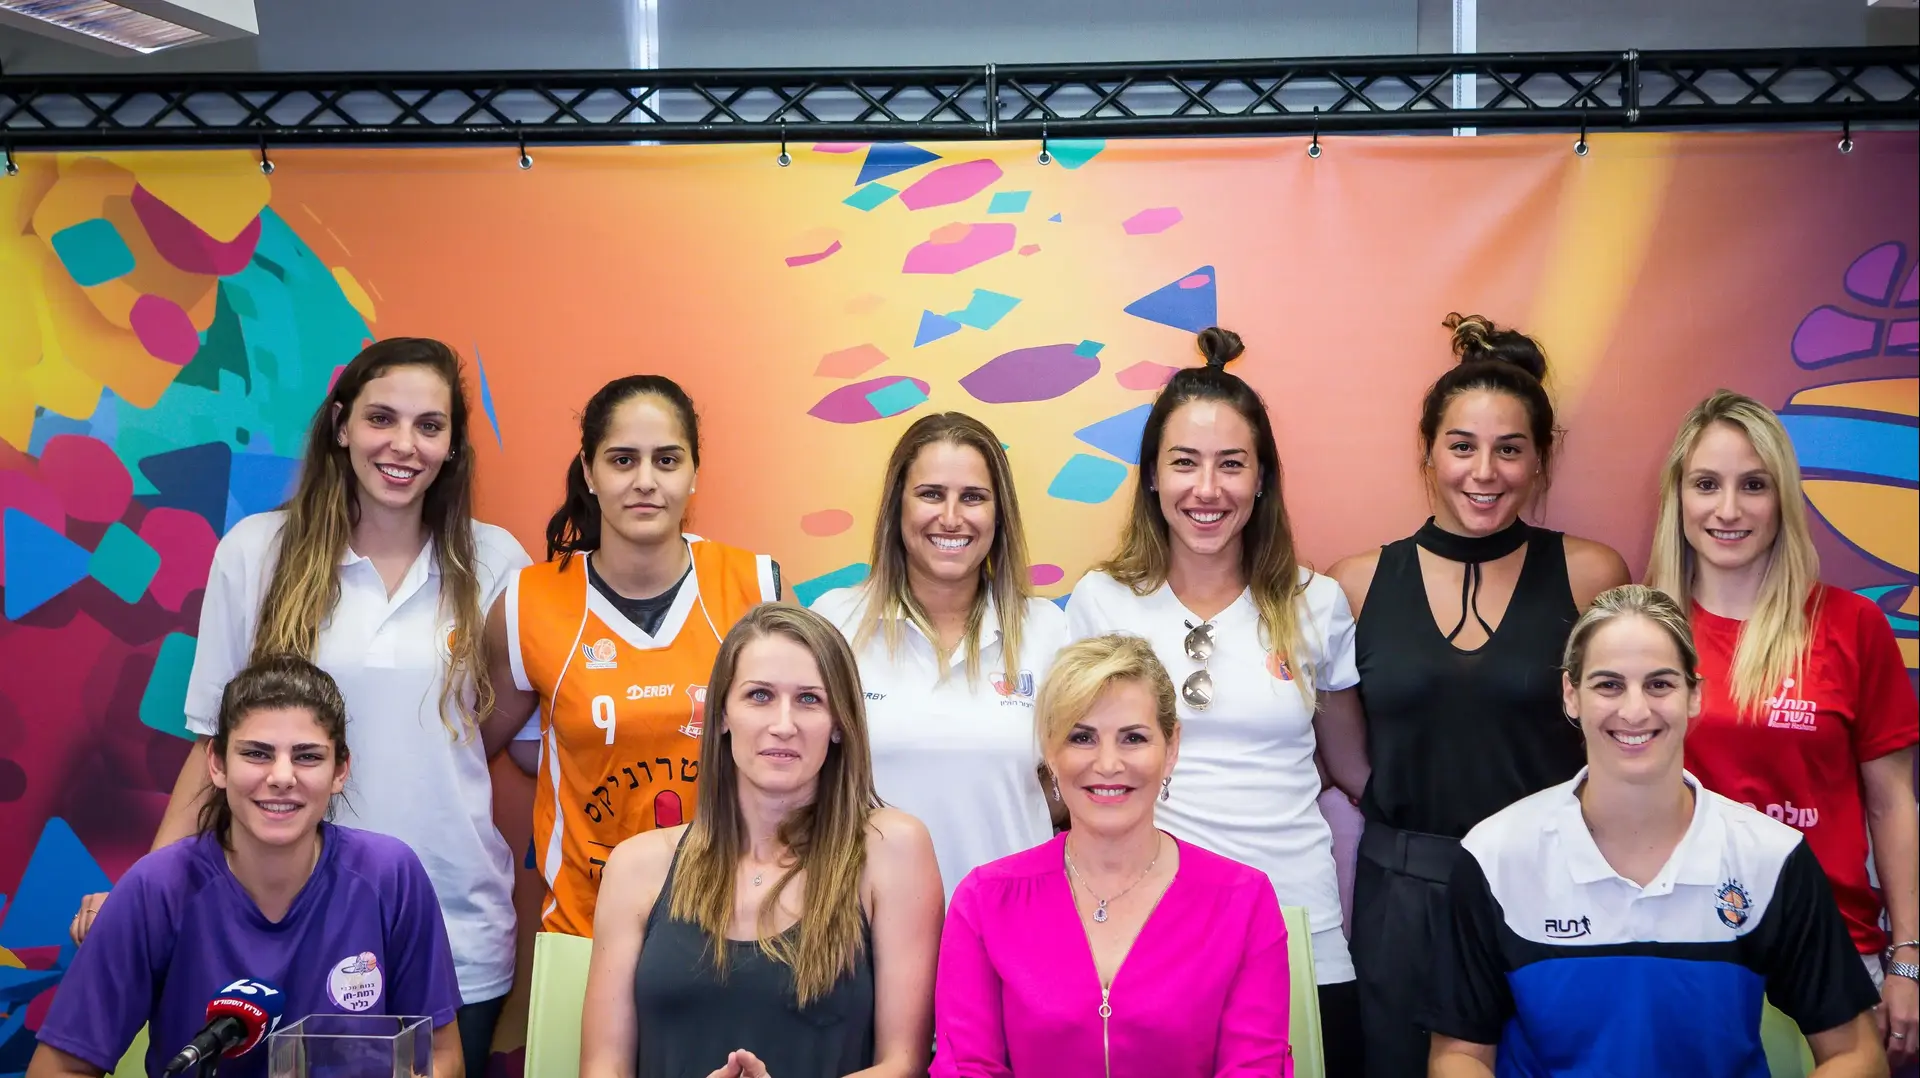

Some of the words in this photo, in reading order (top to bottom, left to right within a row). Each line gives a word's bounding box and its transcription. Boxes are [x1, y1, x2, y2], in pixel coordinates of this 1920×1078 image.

[626, 684, 675, 700] DERBY
[592, 695, 616, 744] 9
[1767, 709, 1815, 727] השרון
[584, 757, 699, 823] טרוניקס
[1766, 801, 1819, 828] עולם
[1545, 919, 1579, 933] RUN
[243, 1003, 263, 1017] ערוץ
